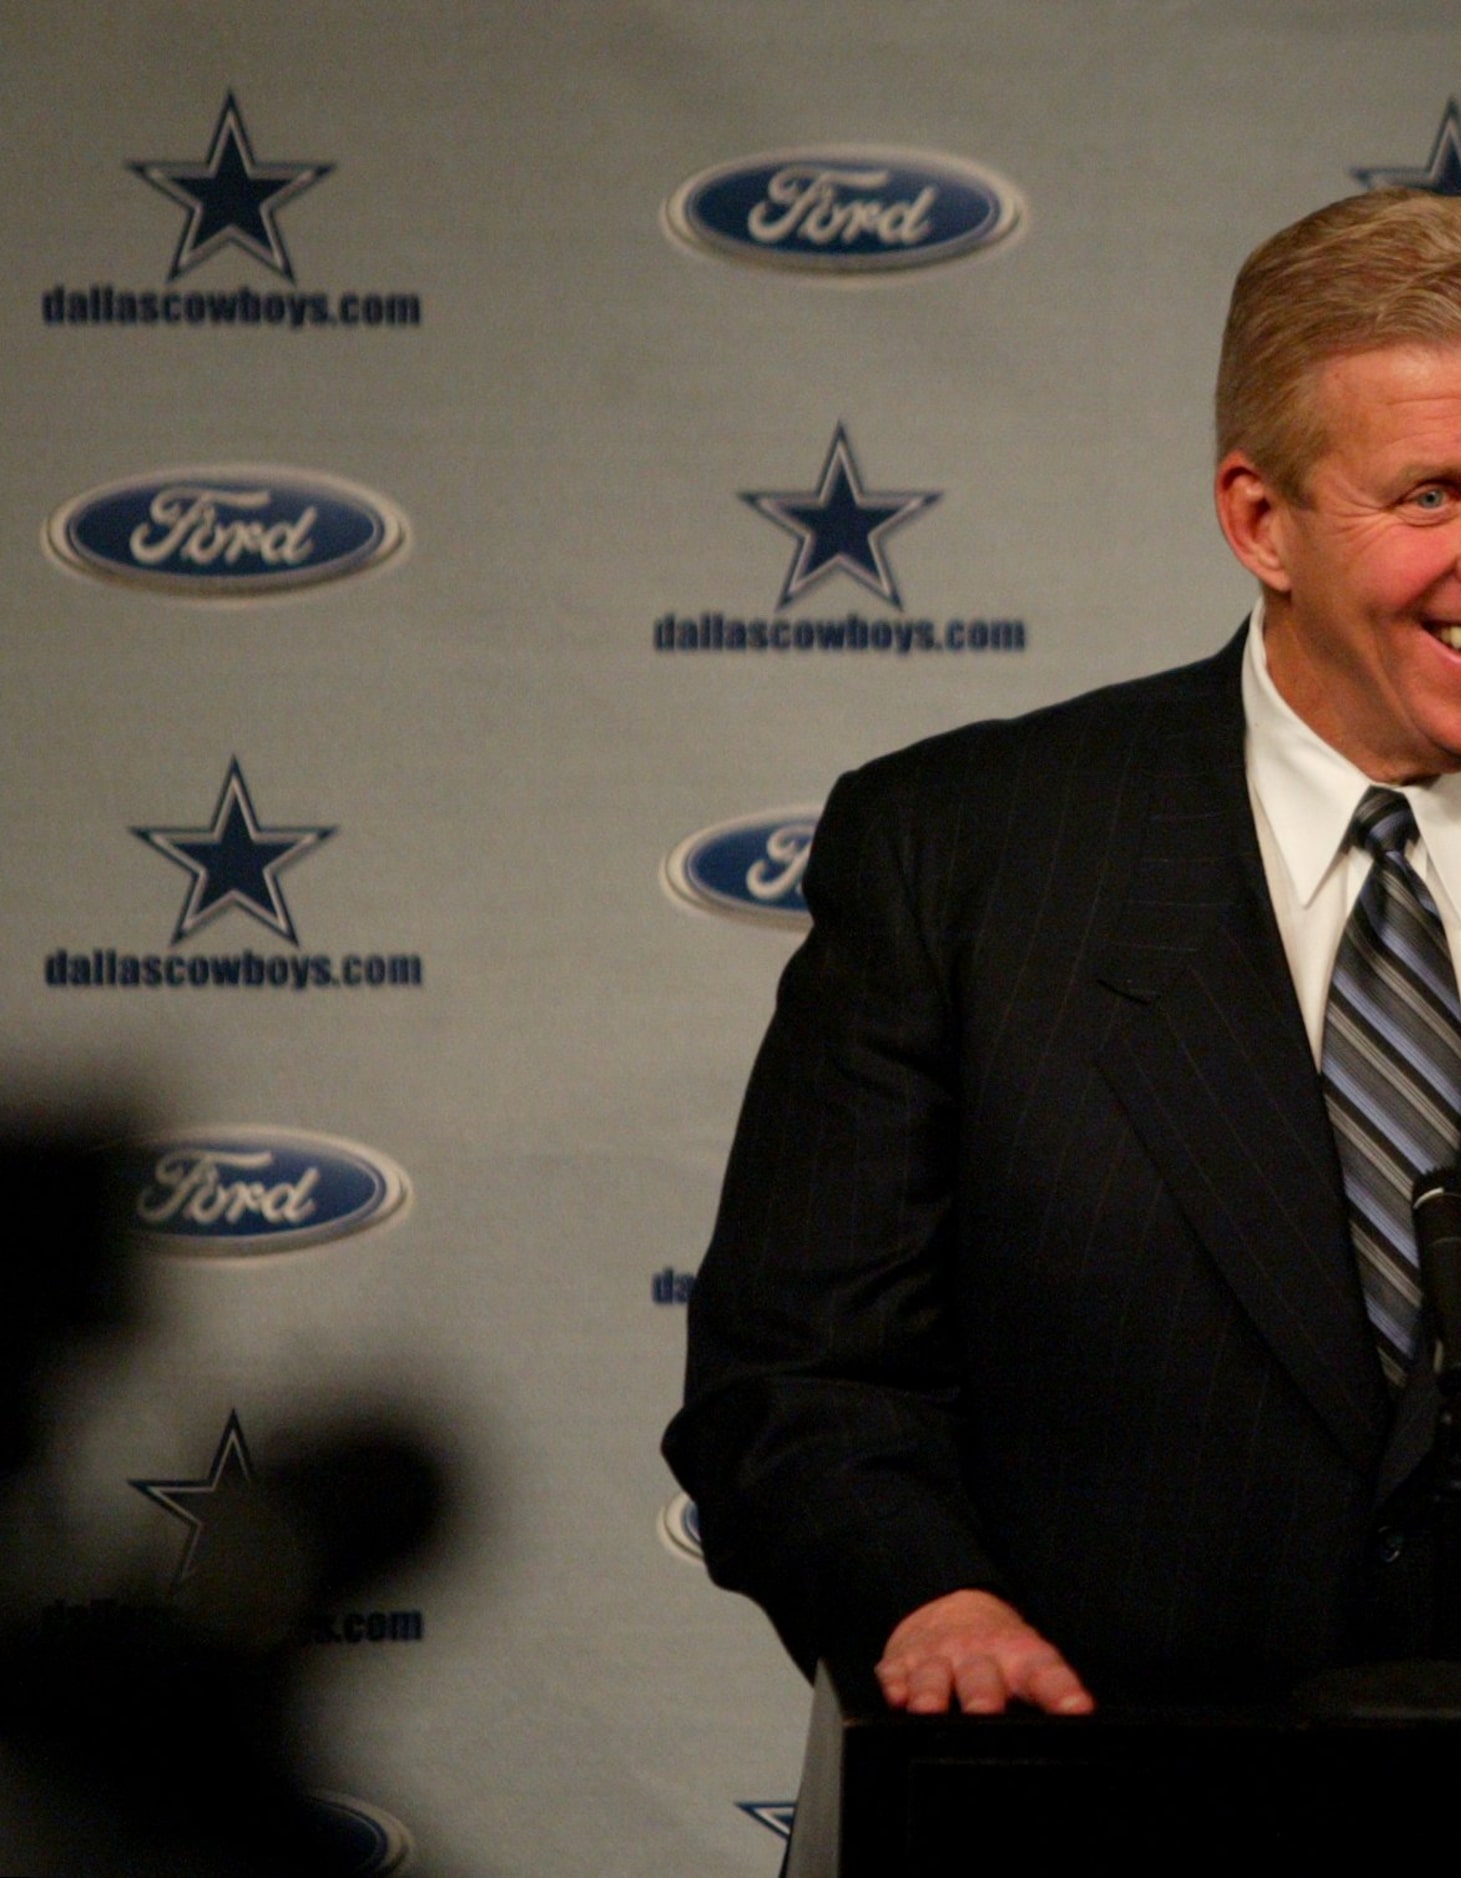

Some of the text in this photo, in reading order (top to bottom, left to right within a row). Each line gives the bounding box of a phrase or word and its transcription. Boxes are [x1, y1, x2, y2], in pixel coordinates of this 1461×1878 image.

[747, 166, 937, 245] Ford
[42, 286, 422, 328] dallascowboys.com
[129, 485, 318, 565] Ford
[654, 613, 1027, 656] dallascowboys.com
[44, 950, 423, 990] dallascowboys.com
[138, 1150, 320, 1224] Ford
